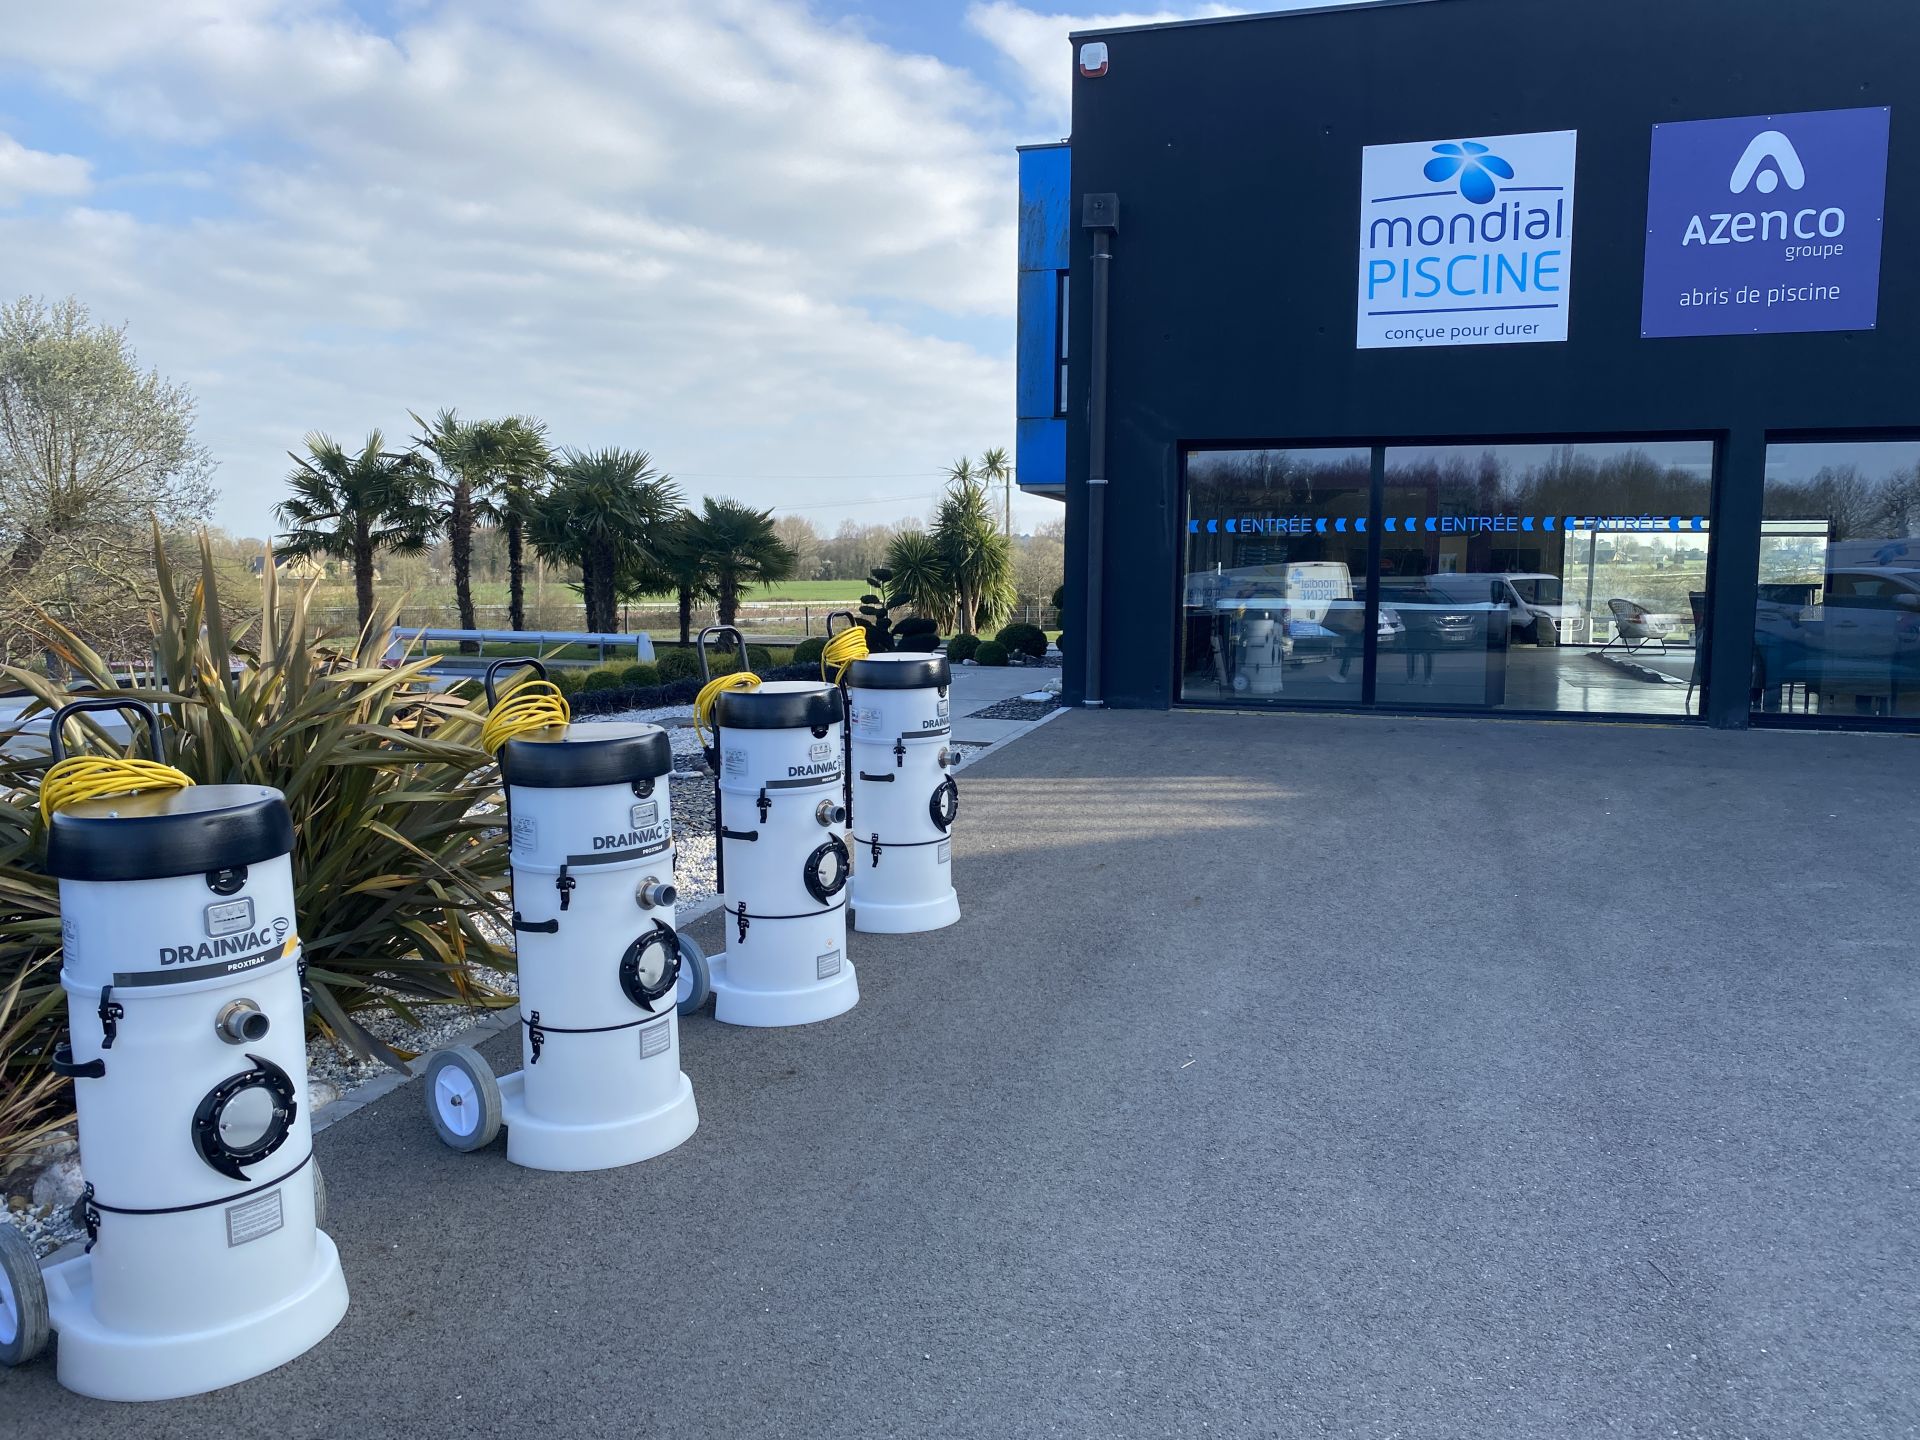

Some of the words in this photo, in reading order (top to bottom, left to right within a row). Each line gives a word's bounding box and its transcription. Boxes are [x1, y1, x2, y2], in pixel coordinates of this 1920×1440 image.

[1370, 198, 1564, 249] mondial
[1785, 243, 1844, 262] groupe
[1368, 250, 1561, 300] PISCINE
[1679, 287, 1729, 306] abris
[1736, 285, 1760, 304] de
[1767, 282, 1840, 307] piscine
[1384, 327, 1446, 342] conçue
[1450, 324, 1490, 341] pour
[1494, 322, 1540, 336] durer
[1240, 514, 1313, 533] ENTRÉE
[1441, 512, 1518, 532] ENTRÉE
[1584, 512, 1665, 532] ENTRÉE
[788, 760, 838, 777] DRAINVAC
[592, 825, 663, 850] DRAINVAC
[159, 927, 272, 966] DRAINVAC
[227, 955, 266, 973] PROXTRAK
